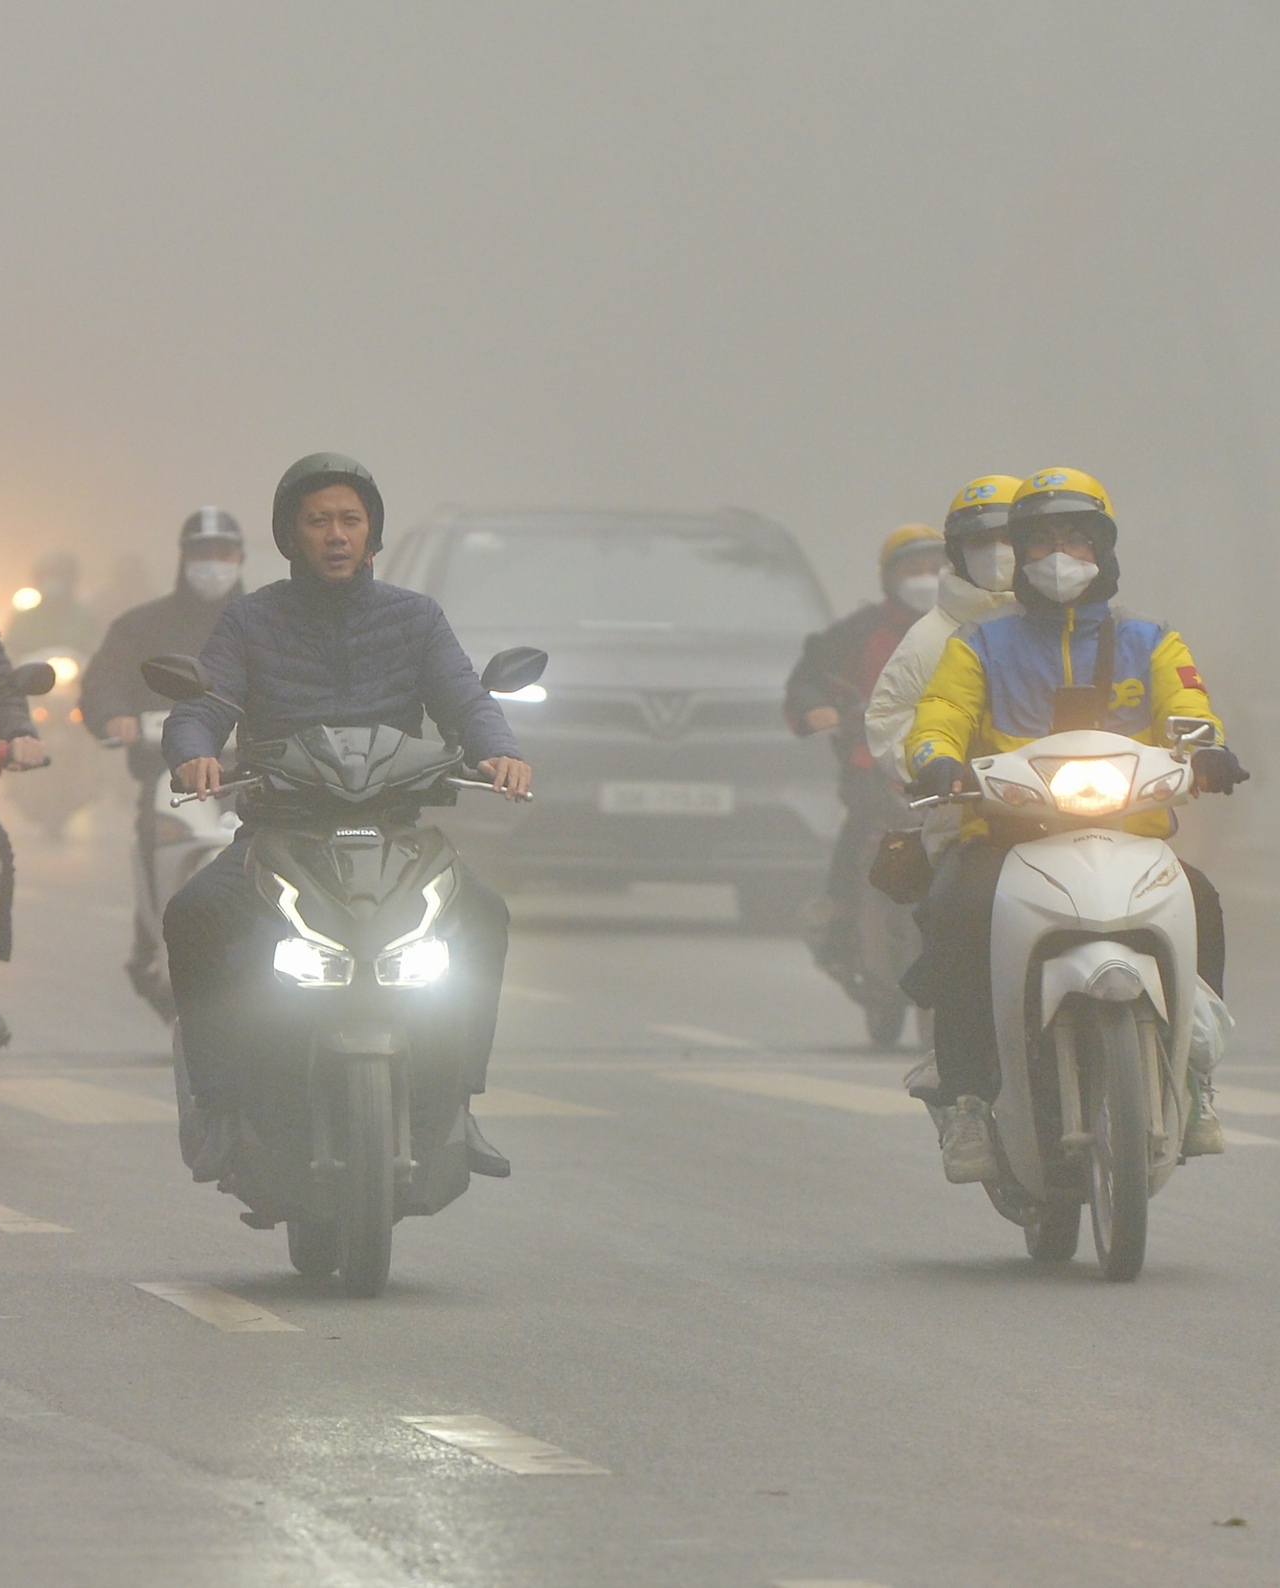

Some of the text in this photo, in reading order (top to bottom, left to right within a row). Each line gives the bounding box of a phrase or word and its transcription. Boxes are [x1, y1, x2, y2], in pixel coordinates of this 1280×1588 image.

[1032, 473, 1068, 489] be
[963, 484, 997, 502] be
[335, 829, 378, 837] HONDA
[1072, 833, 1114, 844] HONDA
